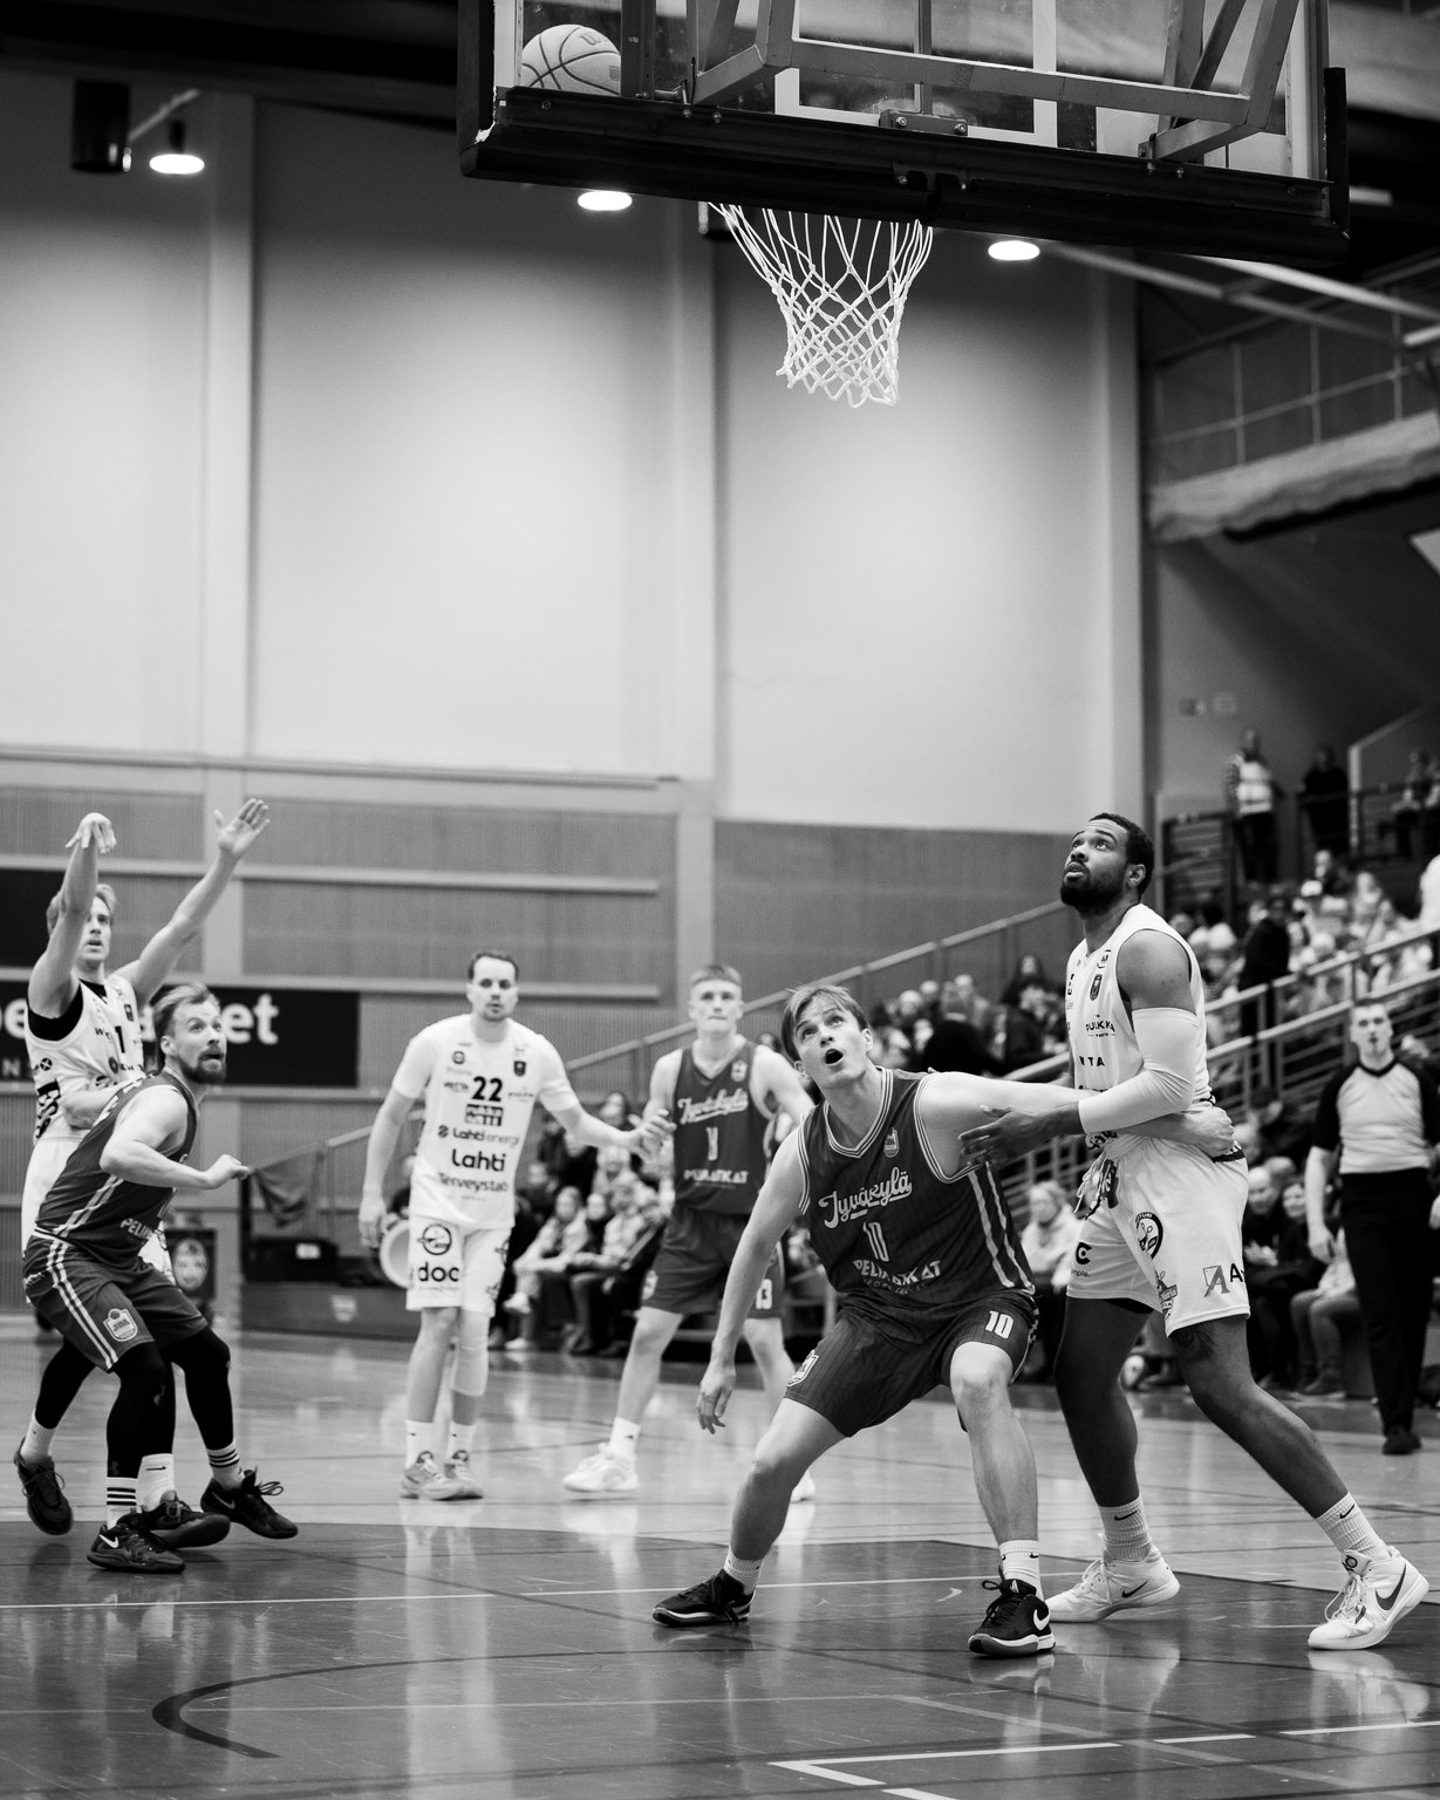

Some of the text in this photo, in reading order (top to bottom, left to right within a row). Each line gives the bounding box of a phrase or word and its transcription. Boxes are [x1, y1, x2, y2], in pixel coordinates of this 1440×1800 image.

[471, 1075, 503, 1102] 22
[452, 1149, 506, 1172] Lahti
[819, 1167, 913, 1229] Jyväkylä
[863, 1222, 890, 1262] 10
[418, 1261, 460, 1282] doc
[985, 1310, 1014, 1339] 10
